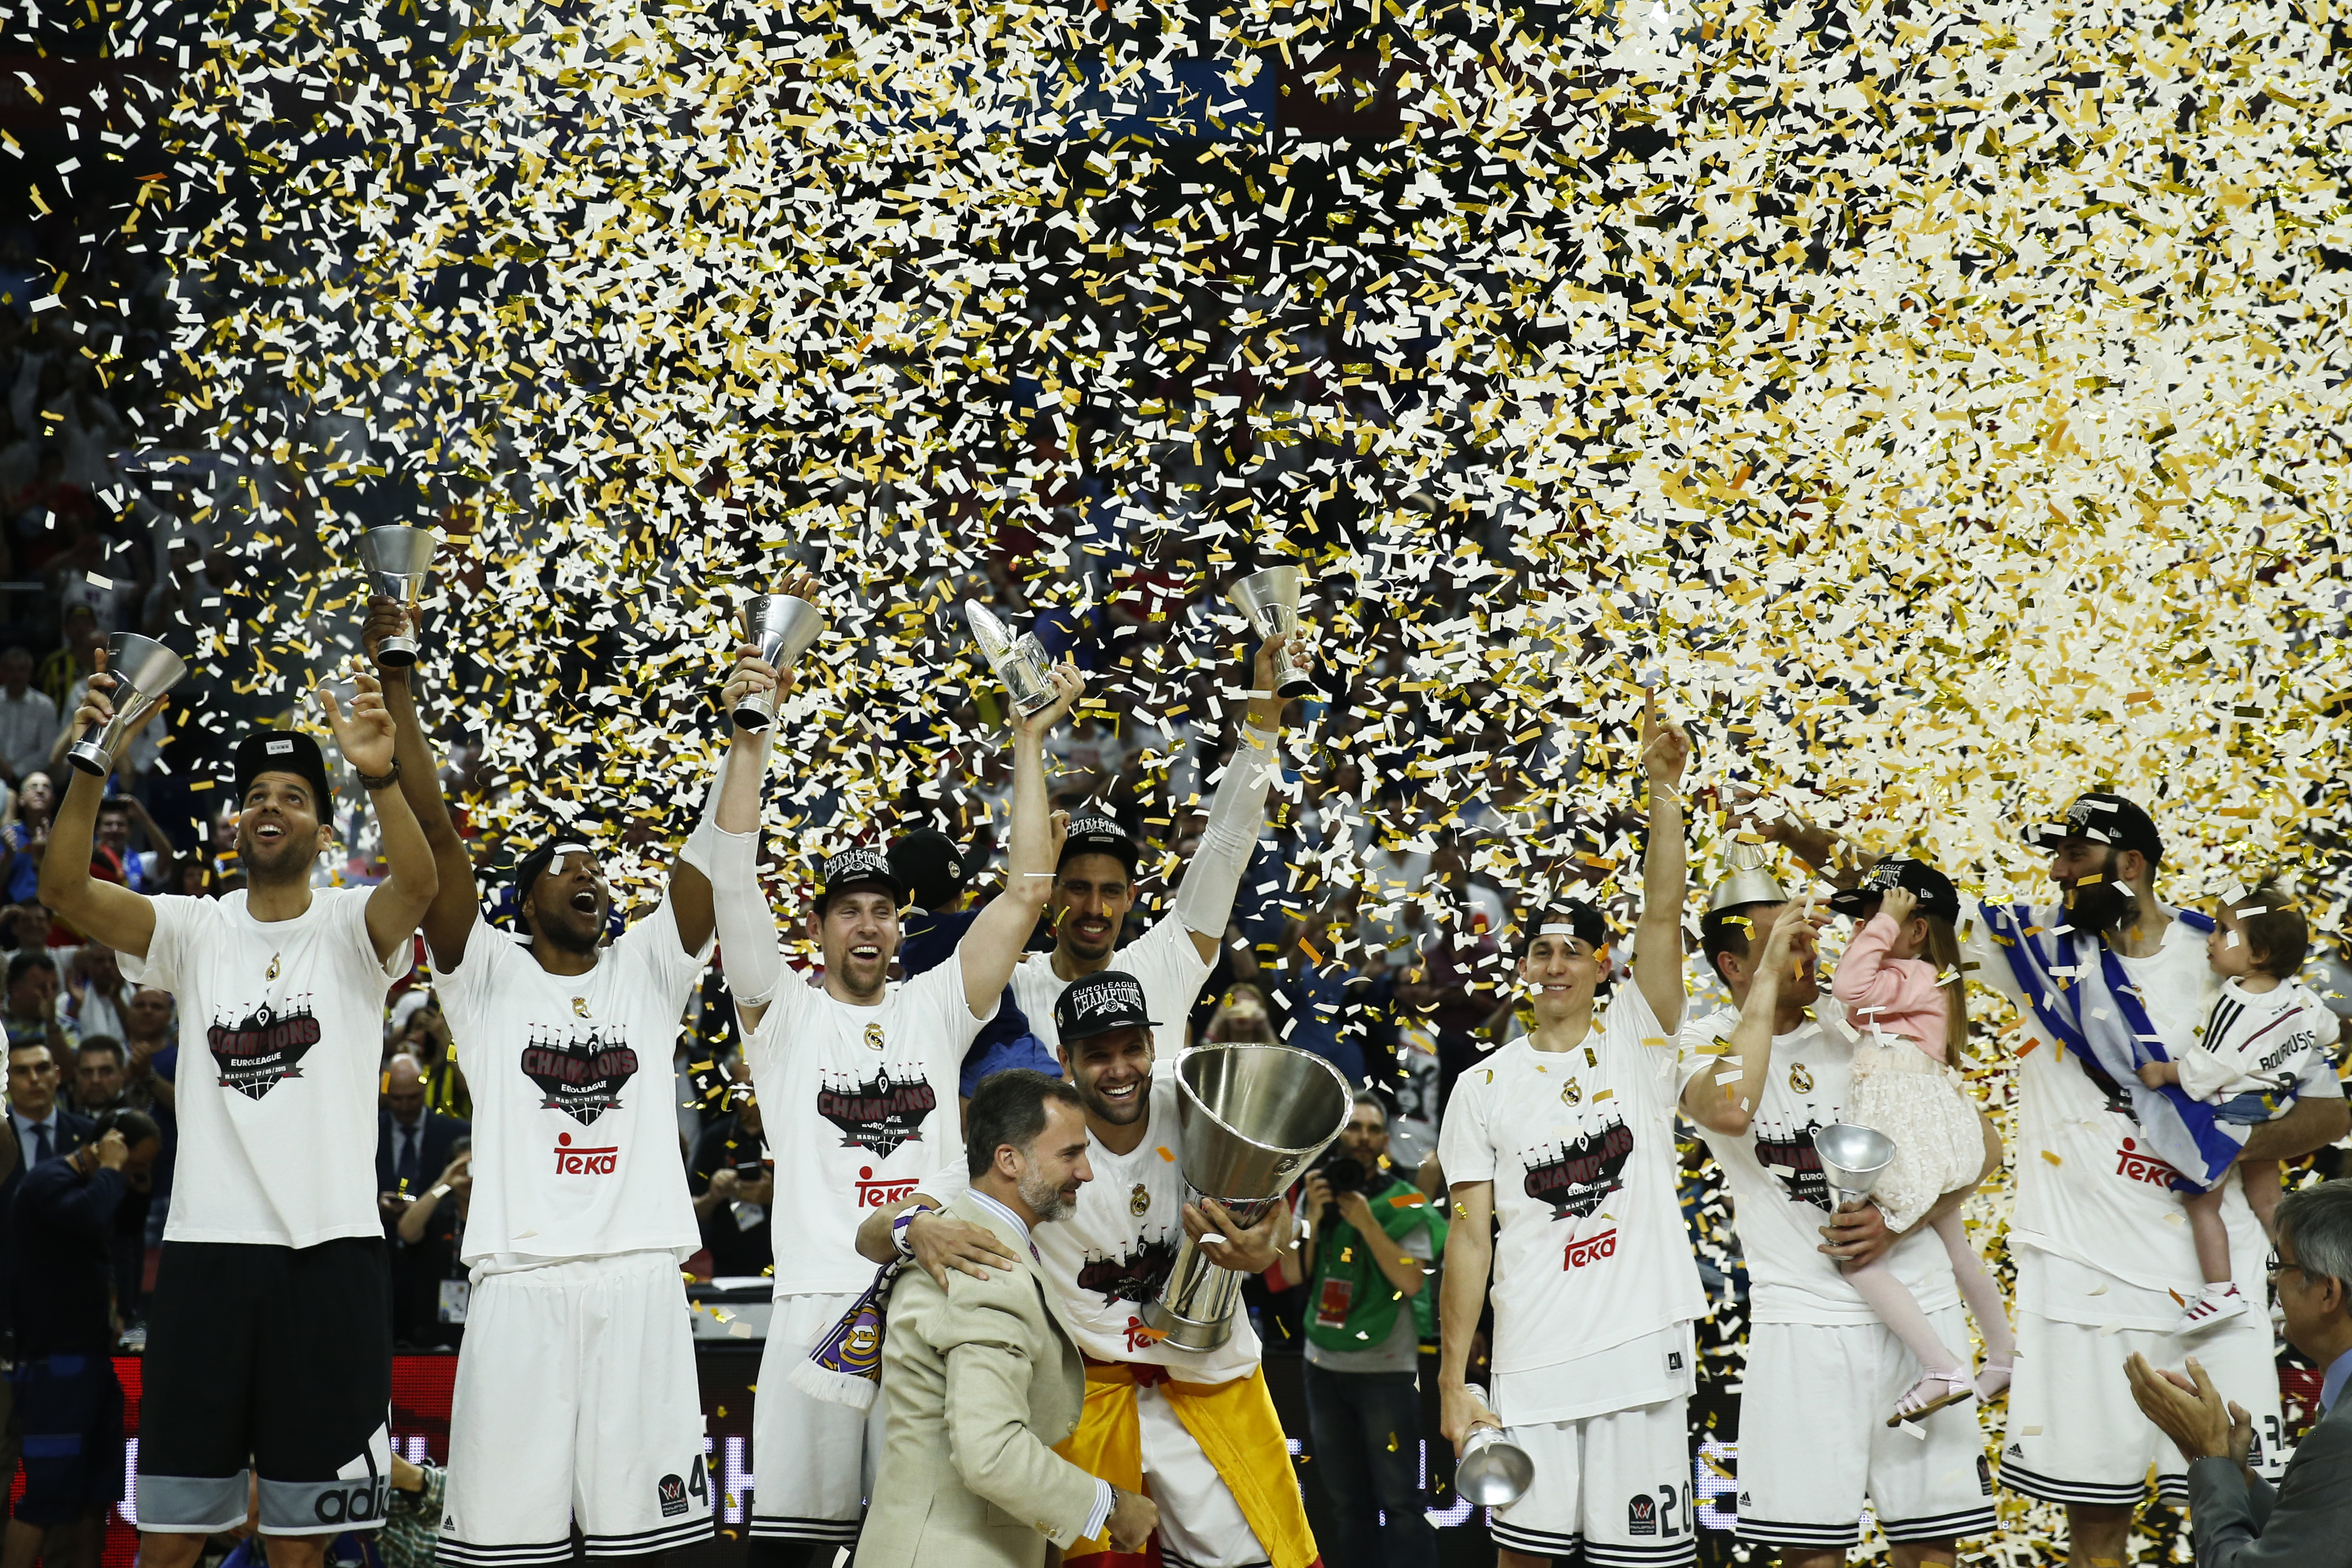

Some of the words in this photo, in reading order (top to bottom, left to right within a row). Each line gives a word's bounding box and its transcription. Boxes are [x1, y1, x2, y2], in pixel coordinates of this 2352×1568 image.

[824, 853, 889, 883] CHAMPIONS
[1072, 981, 1138, 998] EUROLEAGUE
[1073, 987, 1143, 1020] CHAMPIONS
[259, 1011, 267, 1022] 9
[231, 1052, 281, 1066] EUROLEAGUE
[561, 1080, 607, 1094] EROLEAGUE
[881, 1078, 886, 1089] 9
[1580, 1137, 1586, 1147] 9
[1800, 1173, 1827, 1181] EUROL
[1565, 1198, 1589, 1211] MADRI
[688, 1454, 708, 1507] 4
[315, 1475, 390, 1524] adi
[1659, 1480, 1691, 1538] 20
